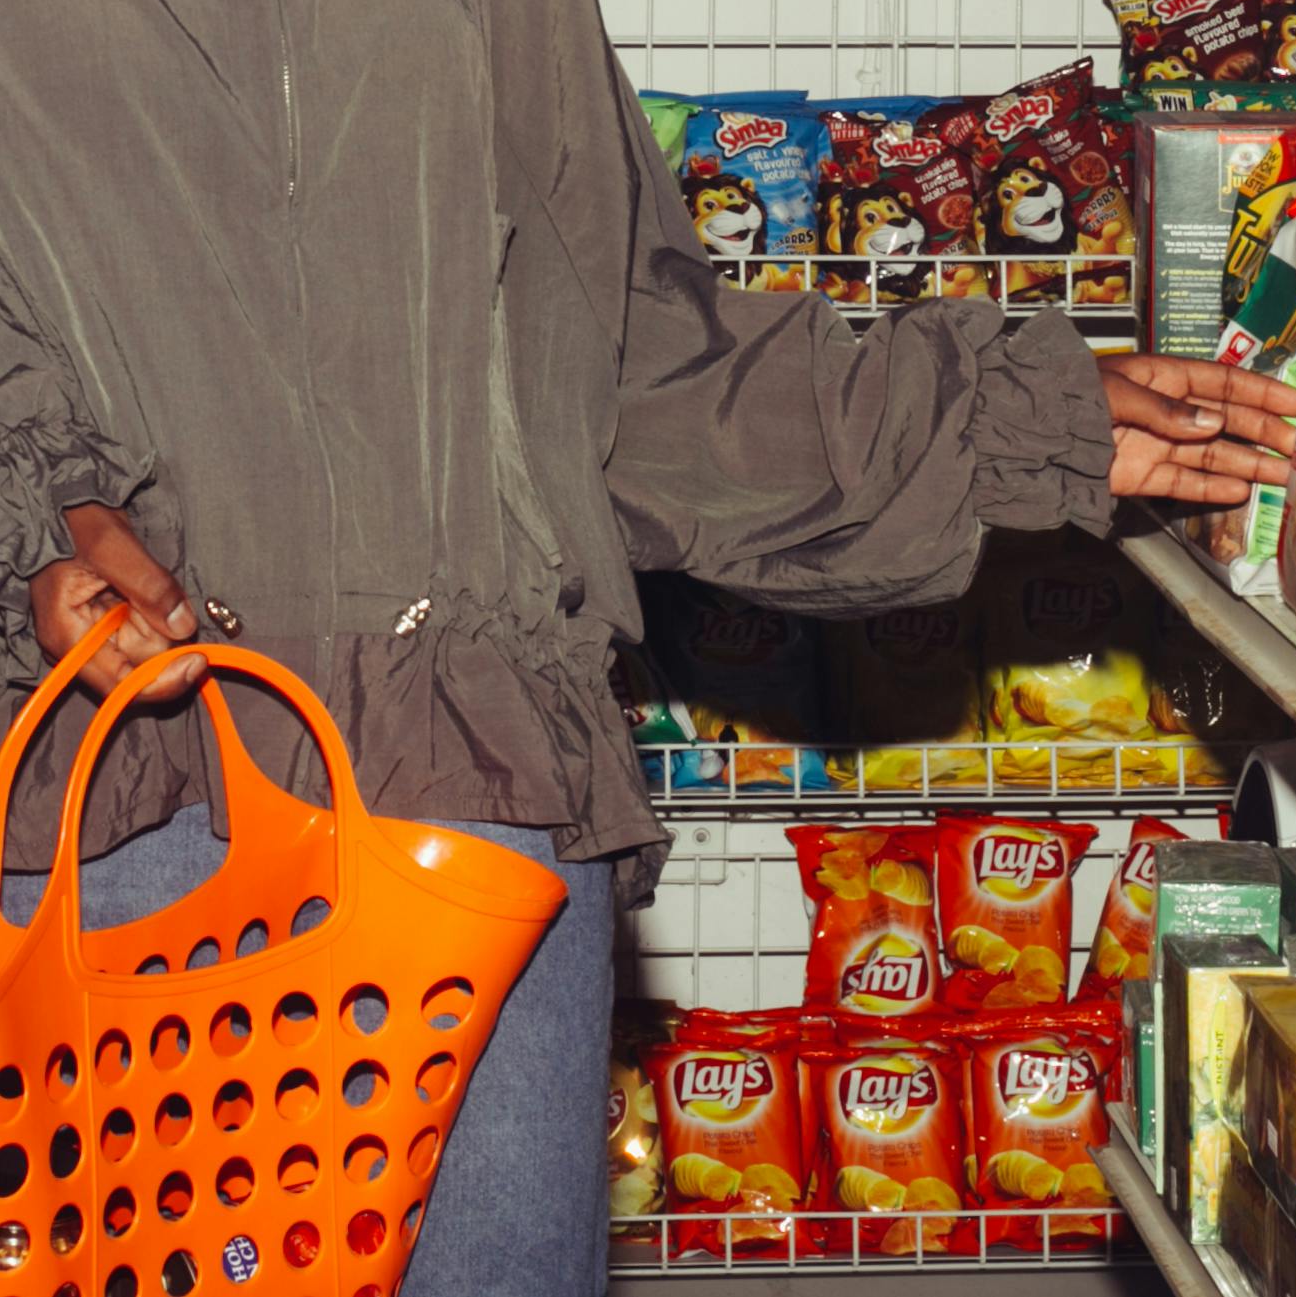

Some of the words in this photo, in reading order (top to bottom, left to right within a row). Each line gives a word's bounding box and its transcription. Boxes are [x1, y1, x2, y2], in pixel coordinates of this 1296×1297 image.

[1184, 14, 1224, 39] smoked
[1192, 20, 1241, 45] flavoured
[1203, 32, 1236, 55] potato
[987, 97, 1051, 140] Simba
[1159, 95, 1187, 111] WIN
[717, 118, 784, 150] Simba
[875, 138, 941, 164] Simba
[978, 832, 1060, 889] Lay's
[846, 956, 921, 1003] Lay's
[680, 1057, 768, 1111] Lay's
[845, 1068, 932, 1120] Lay's
[1004, 1051, 1091, 1104] Lay's
